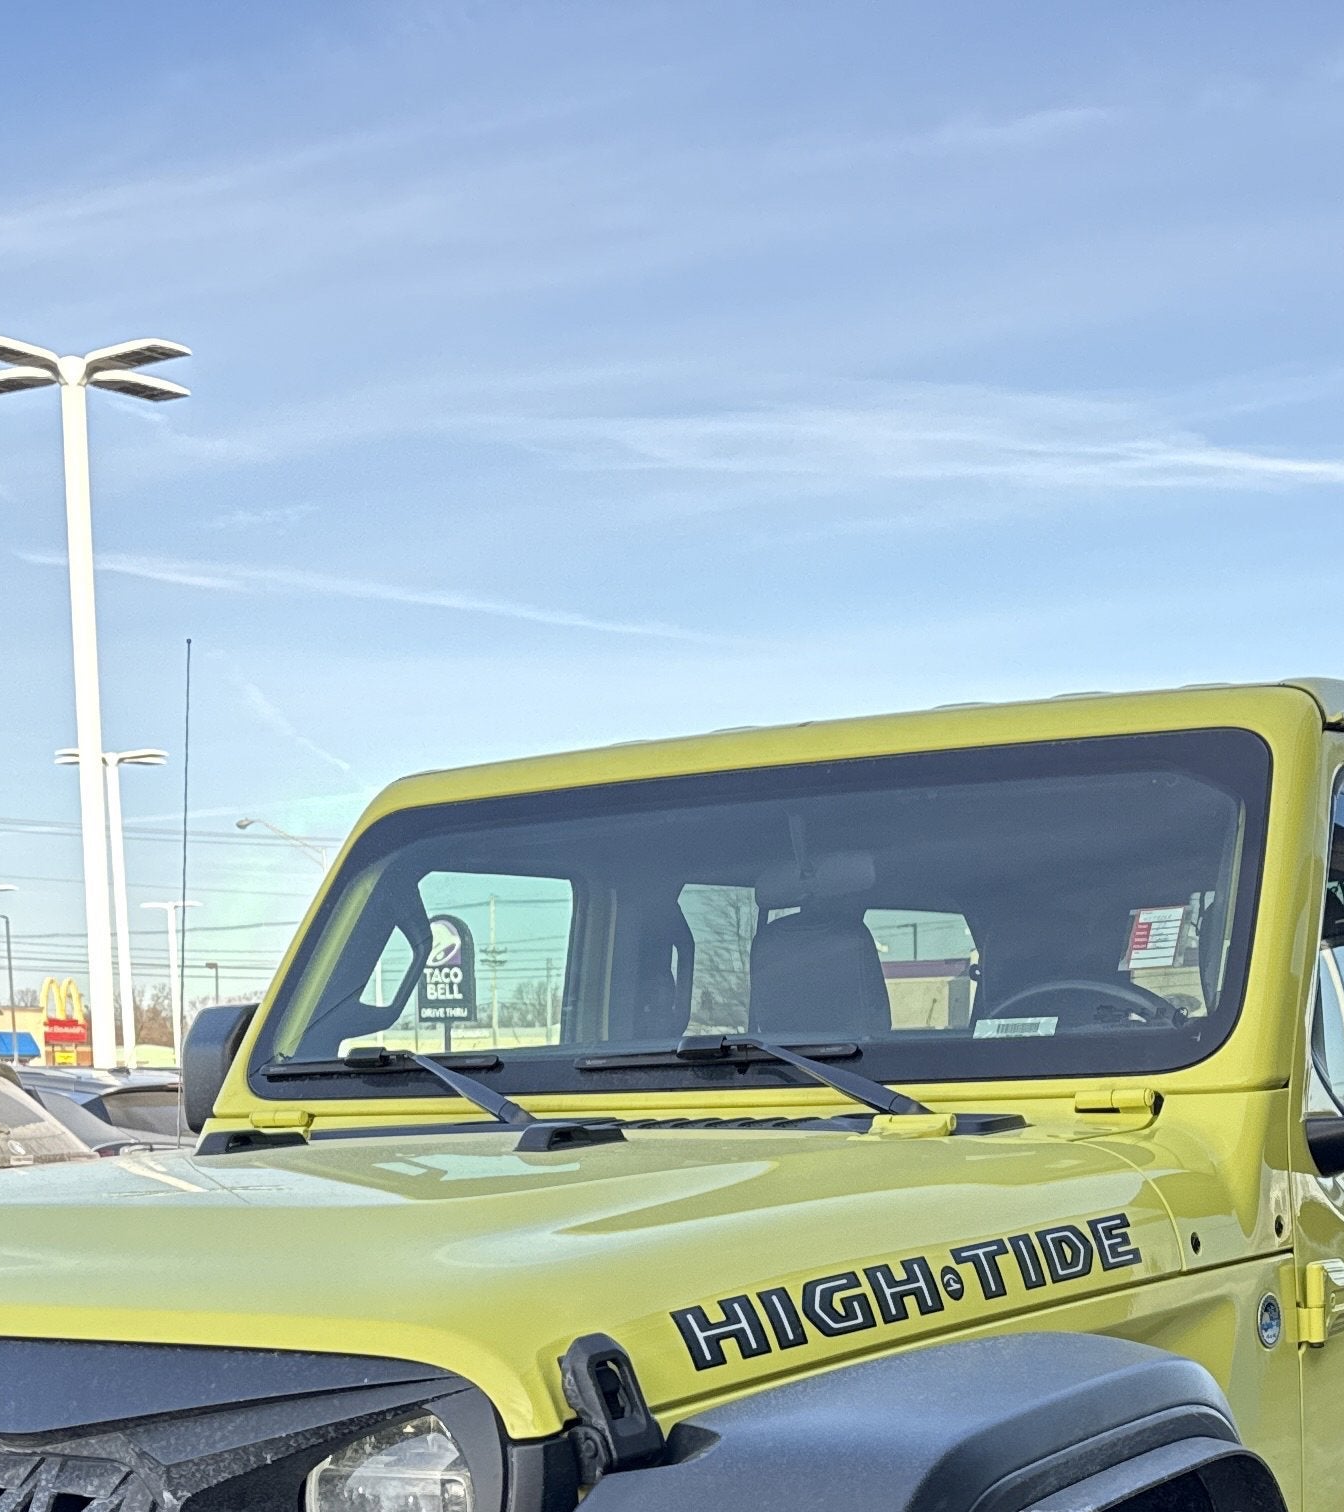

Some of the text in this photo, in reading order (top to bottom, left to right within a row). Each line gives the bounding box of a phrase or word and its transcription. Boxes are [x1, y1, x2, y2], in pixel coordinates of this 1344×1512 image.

[423, 967, 463, 984] TACO
[427, 983, 463, 1000] BELL
[421, 1007, 467, 1018] DRIVE THRU
[670, 1212, 1142, 1371] HIGH TIDE
